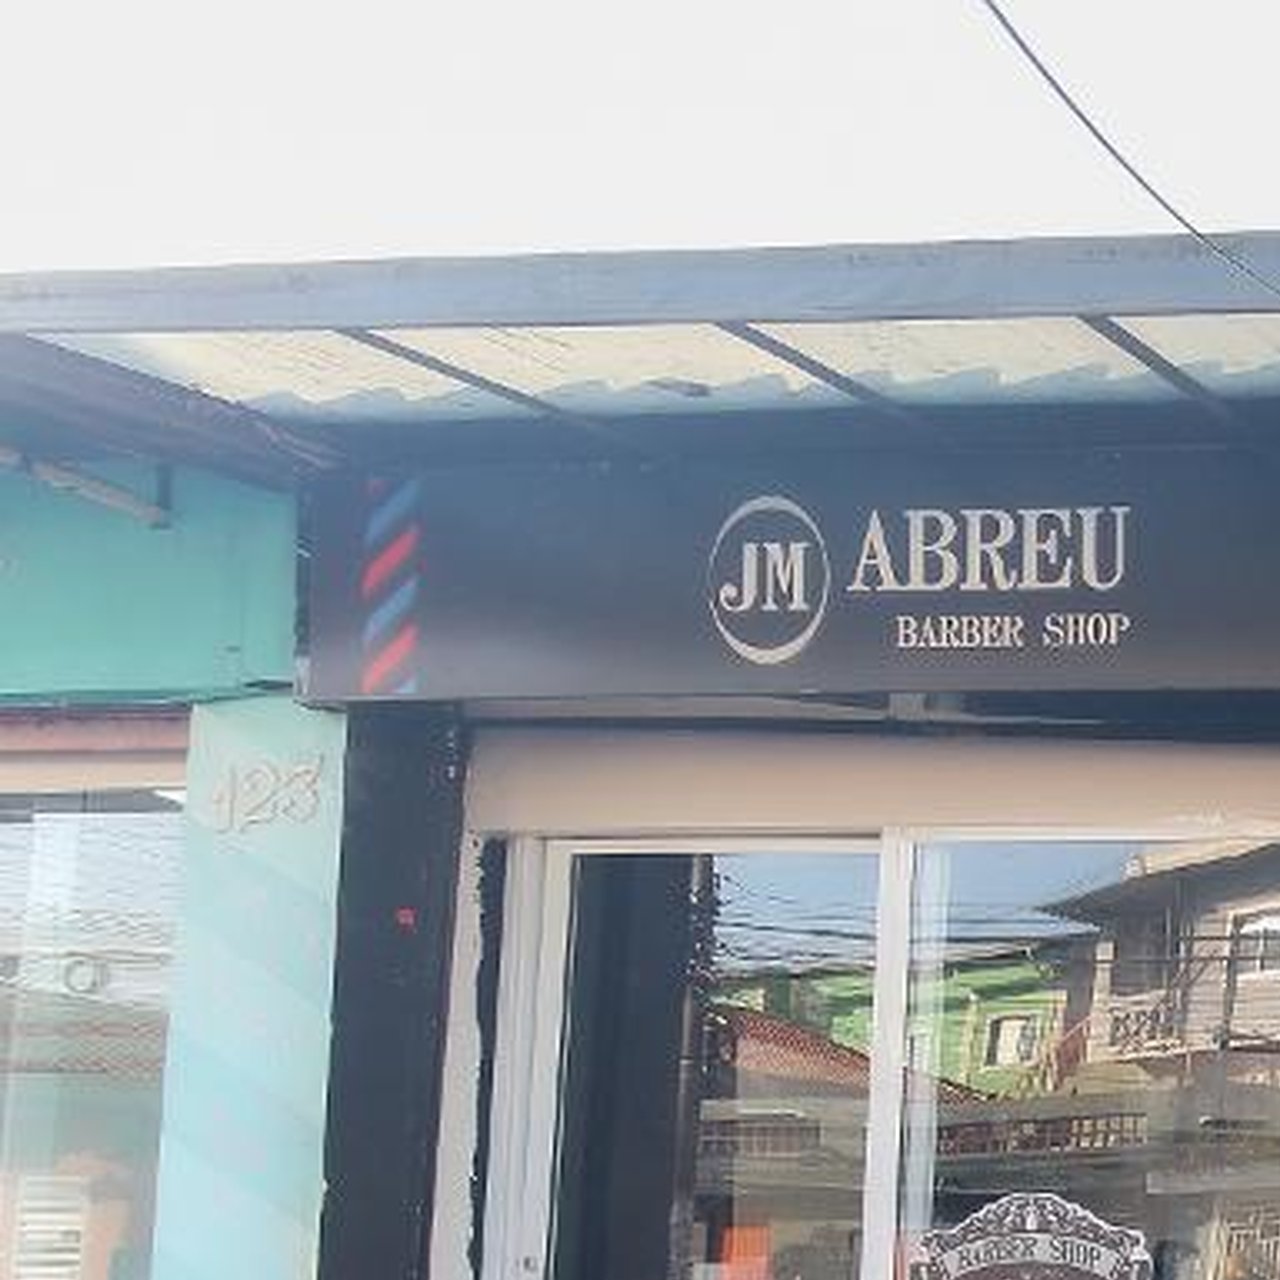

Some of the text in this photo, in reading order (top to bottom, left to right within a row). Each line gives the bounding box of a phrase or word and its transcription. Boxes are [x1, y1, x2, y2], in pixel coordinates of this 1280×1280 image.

[718, 541, 811, 612] JM
[846, 505, 1132, 592] ABREU
[897, 611, 1132, 650] BARBER SHOP
